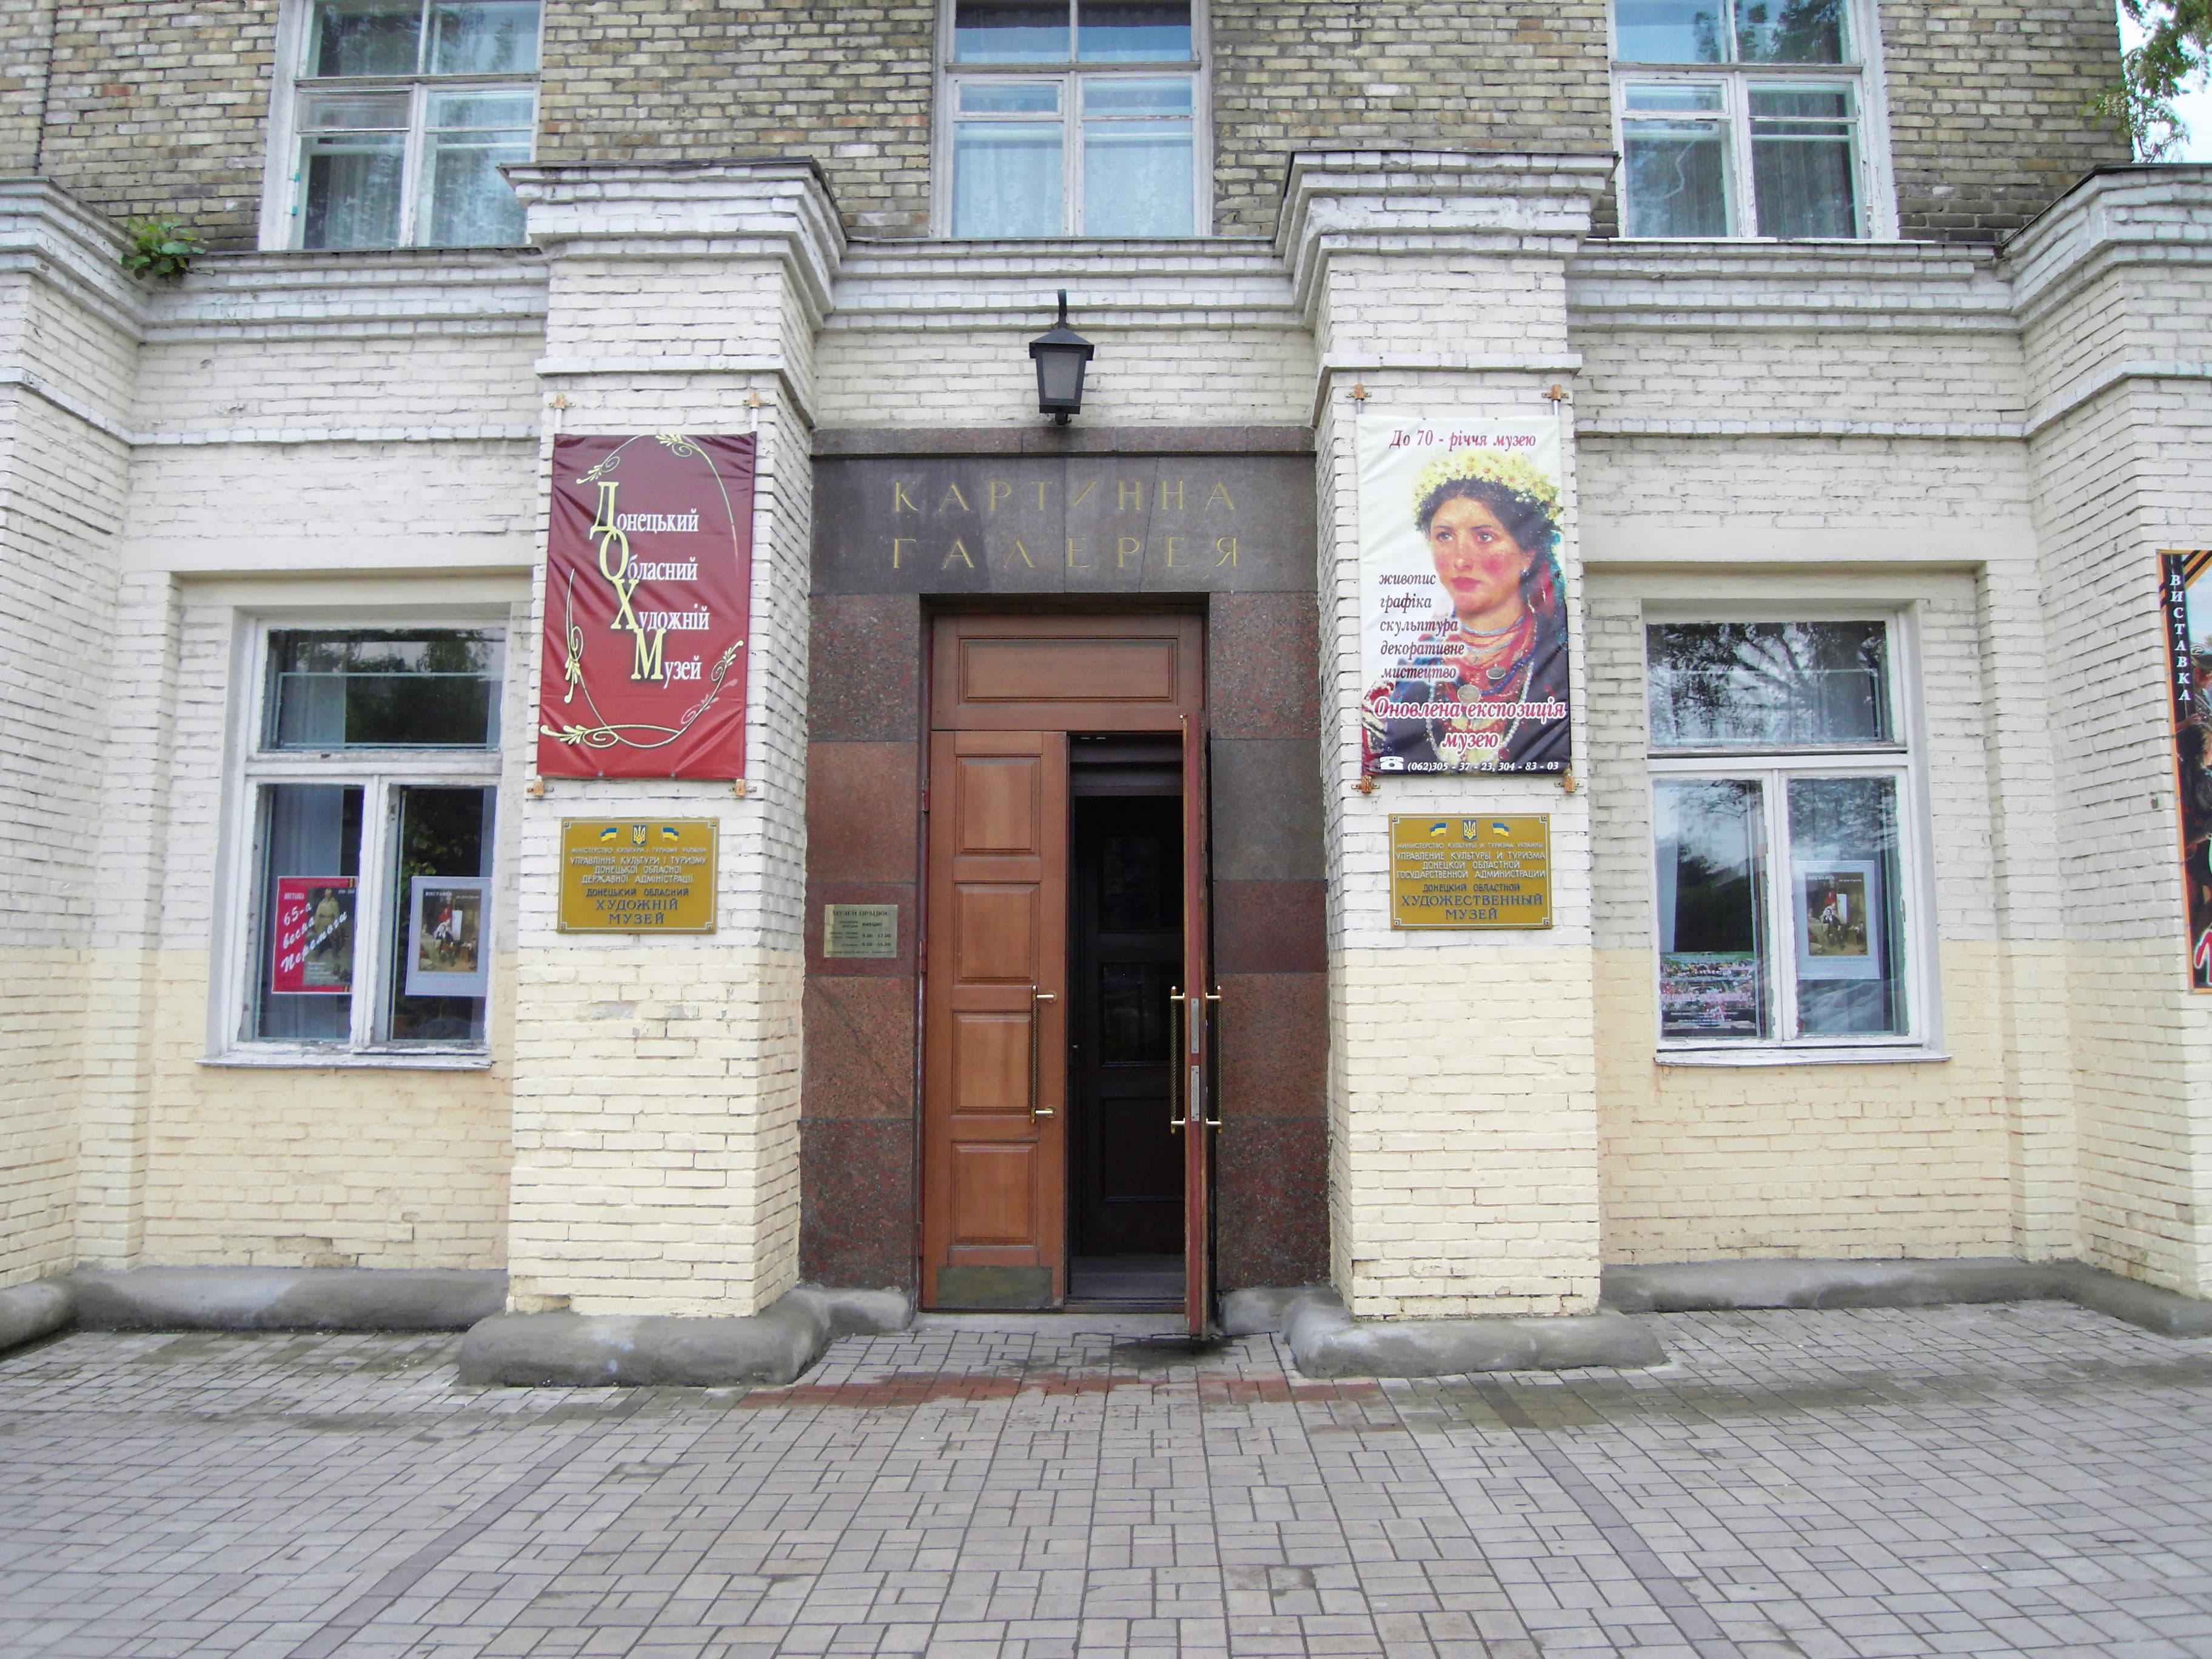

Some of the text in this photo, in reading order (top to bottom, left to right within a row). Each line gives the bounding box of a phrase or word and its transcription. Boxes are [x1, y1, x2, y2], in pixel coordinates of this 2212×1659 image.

[1389, 430, 1410, 449] До
[1417, 429, 1433, 446] 70
[1449, 430, 1487, 452] річчя
[1493, 435, 1536, 452] музею
[893, 480, 1236, 512] КАРТИННА
[589, 481, 699, 541] Донецький
[599, 529, 699, 581] Обласний
[893, 536, 1238, 569] ГАЛЕРЕЯ
[1379, 574, 1436, 585] живопис
[611, 578, 710, 632] Художній
[1380, 592, 1432, 614] графіка
[1380, 617, 1458, 637] скульптура
[2170, 574, 2191, 701] ВИСТАВКА
[1380, 640, 1464, 660] декоративне
[631, 628, 702, 689] Музей
[1381, 668, 1456, 683] мистецтво
[1373, 697, 1566, 724] Оновлена експозиція
[1441, 732, 1499, 755] музею
[1407, 762, 1449, 772] (062)305
[1459, 762, 1470, 771] 37
[1481, 762, 1495, 772] 23,
[1498, 762, 1515, 771] 304
[1525, 762, 1537, 771] 83
[1547, 762, 1559, 770] 03
[570, 857, 615, 865] УПРАВЛІННЯ
[671, 856, 708, 865] ТУРИЗМУ
[1396, 852, 1444, 860] УПРАВЛЕНИЕ
[594, 866, 637, 874] ДОНЕЦЬКОЇ
[1422, 861, 1465, 870] ДОНЕЦКОЙ
[582, 875, 693, 884] ДЕРЖАВНОЇ АДМІНІСТРАЦІЇ
[1396, 870, 1546, 879] ГОСУДАРСТВЕННОЙ АДМИНИСТРАЦИИ
[586, 888, 689, 897] ДОНЕЦЬКИЙ ОБЛАСНИЙ
[1423, 883, 1466, 892] ДОНЕЦКИЙ
[596, 898, 679, 911] ХУДОЖНІЙ
[1401, 893, 1543, 907] ХУДОЖЕСТВЕННЫЙ
[609, 911, 665, 925] МУЗЕЙ
[1446, 907, 1498, 920] МУЗЕЙ
